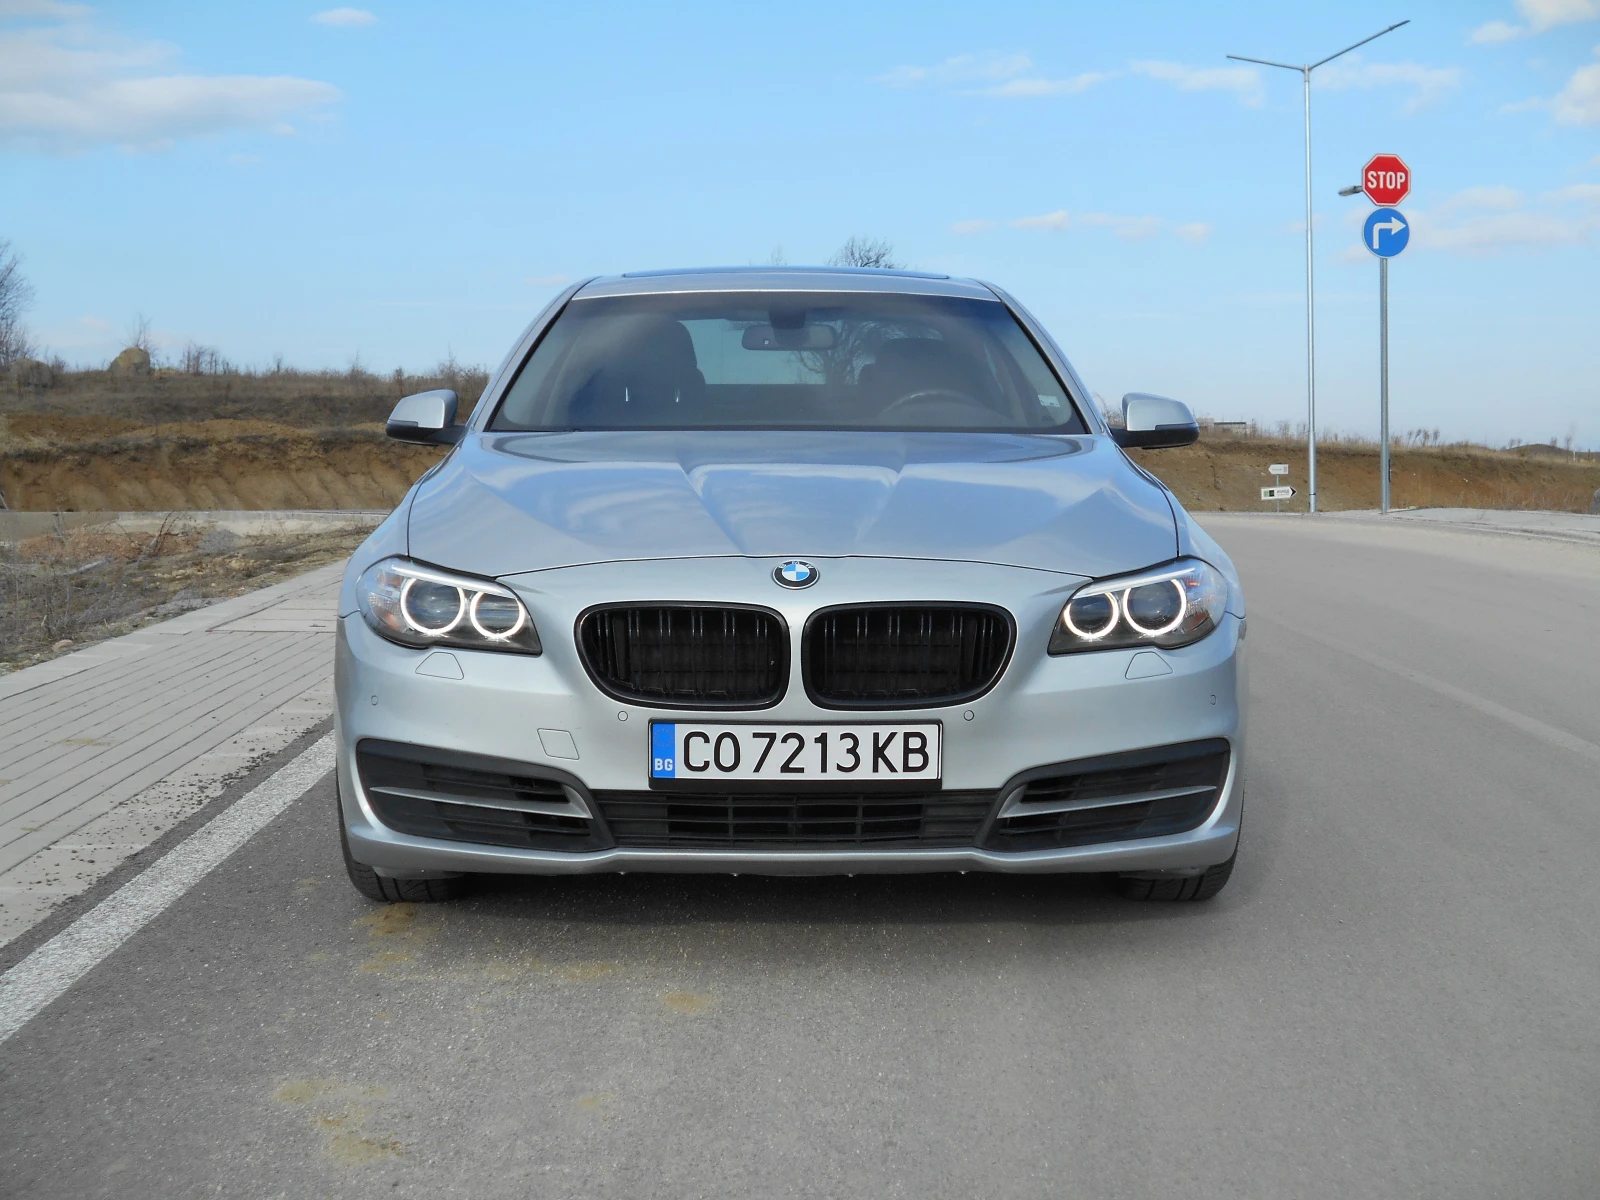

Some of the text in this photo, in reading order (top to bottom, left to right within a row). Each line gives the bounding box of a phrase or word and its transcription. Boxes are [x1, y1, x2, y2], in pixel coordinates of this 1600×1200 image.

[1367, 170, 1406, 189] STOP
[752, 731, 861, 773] 7213
[872, 731, 930, 773] KB
[654, 758, 673, 771] BG
